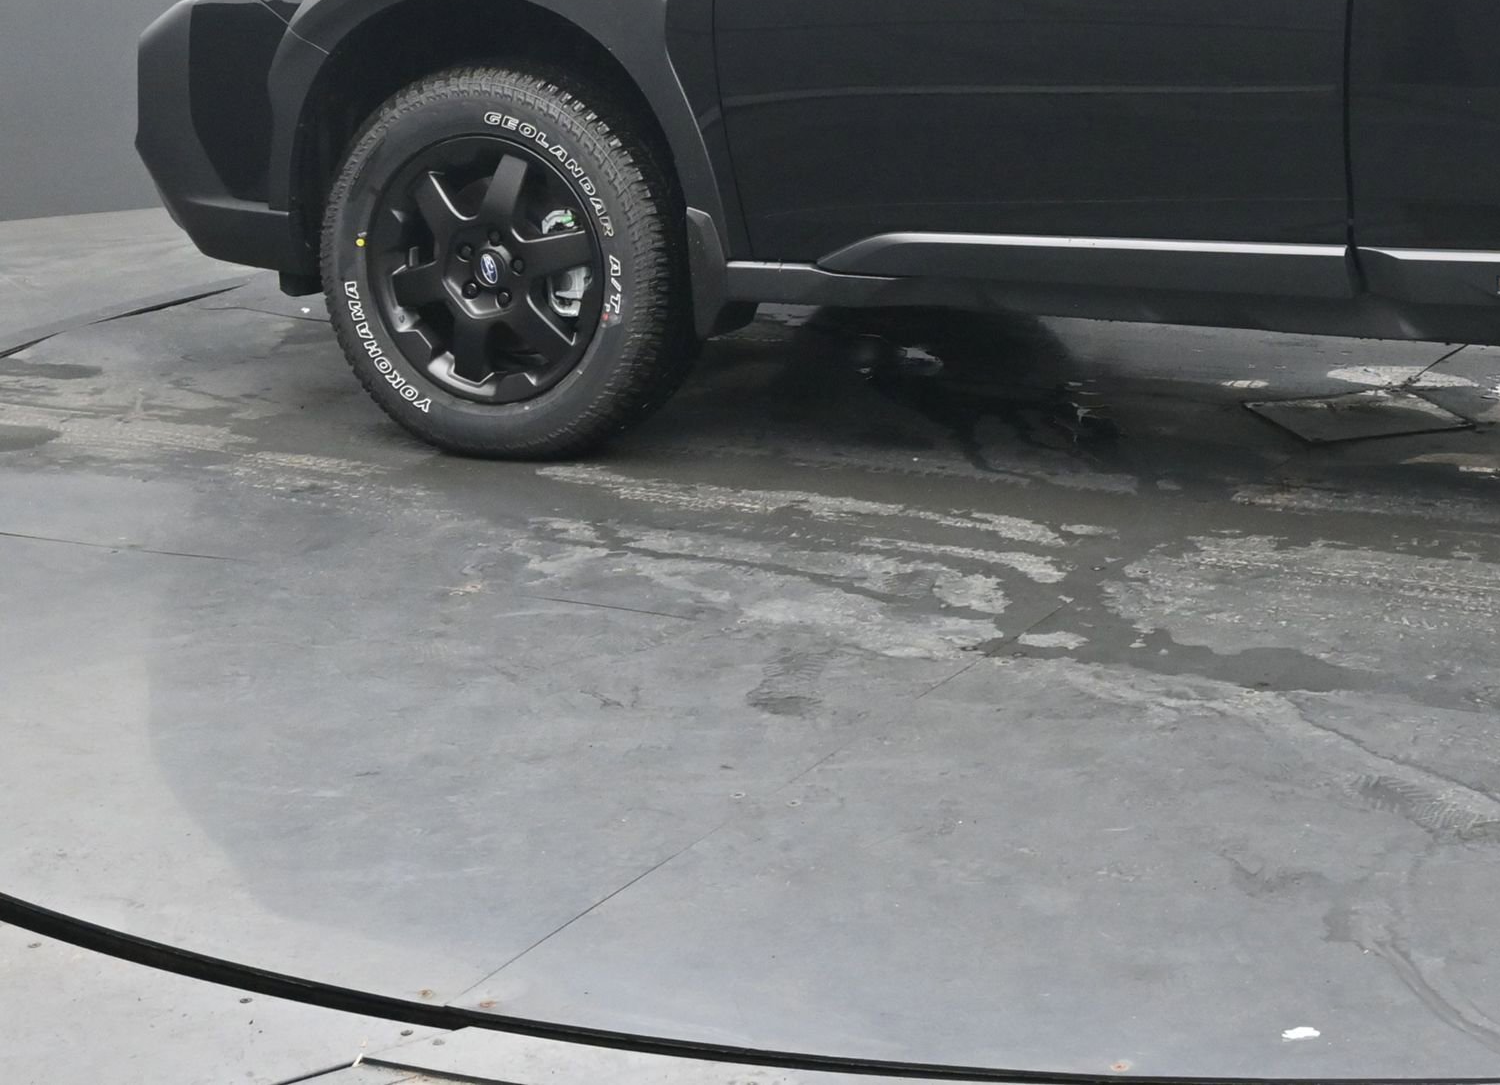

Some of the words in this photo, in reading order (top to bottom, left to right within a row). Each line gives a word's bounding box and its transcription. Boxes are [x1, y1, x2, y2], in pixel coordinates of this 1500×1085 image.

[483, 110, 615, 238] GEOLANDAR
[607, 253, 624, 315] A/T
[343, 280, 432, 413] YOKOHAMA
